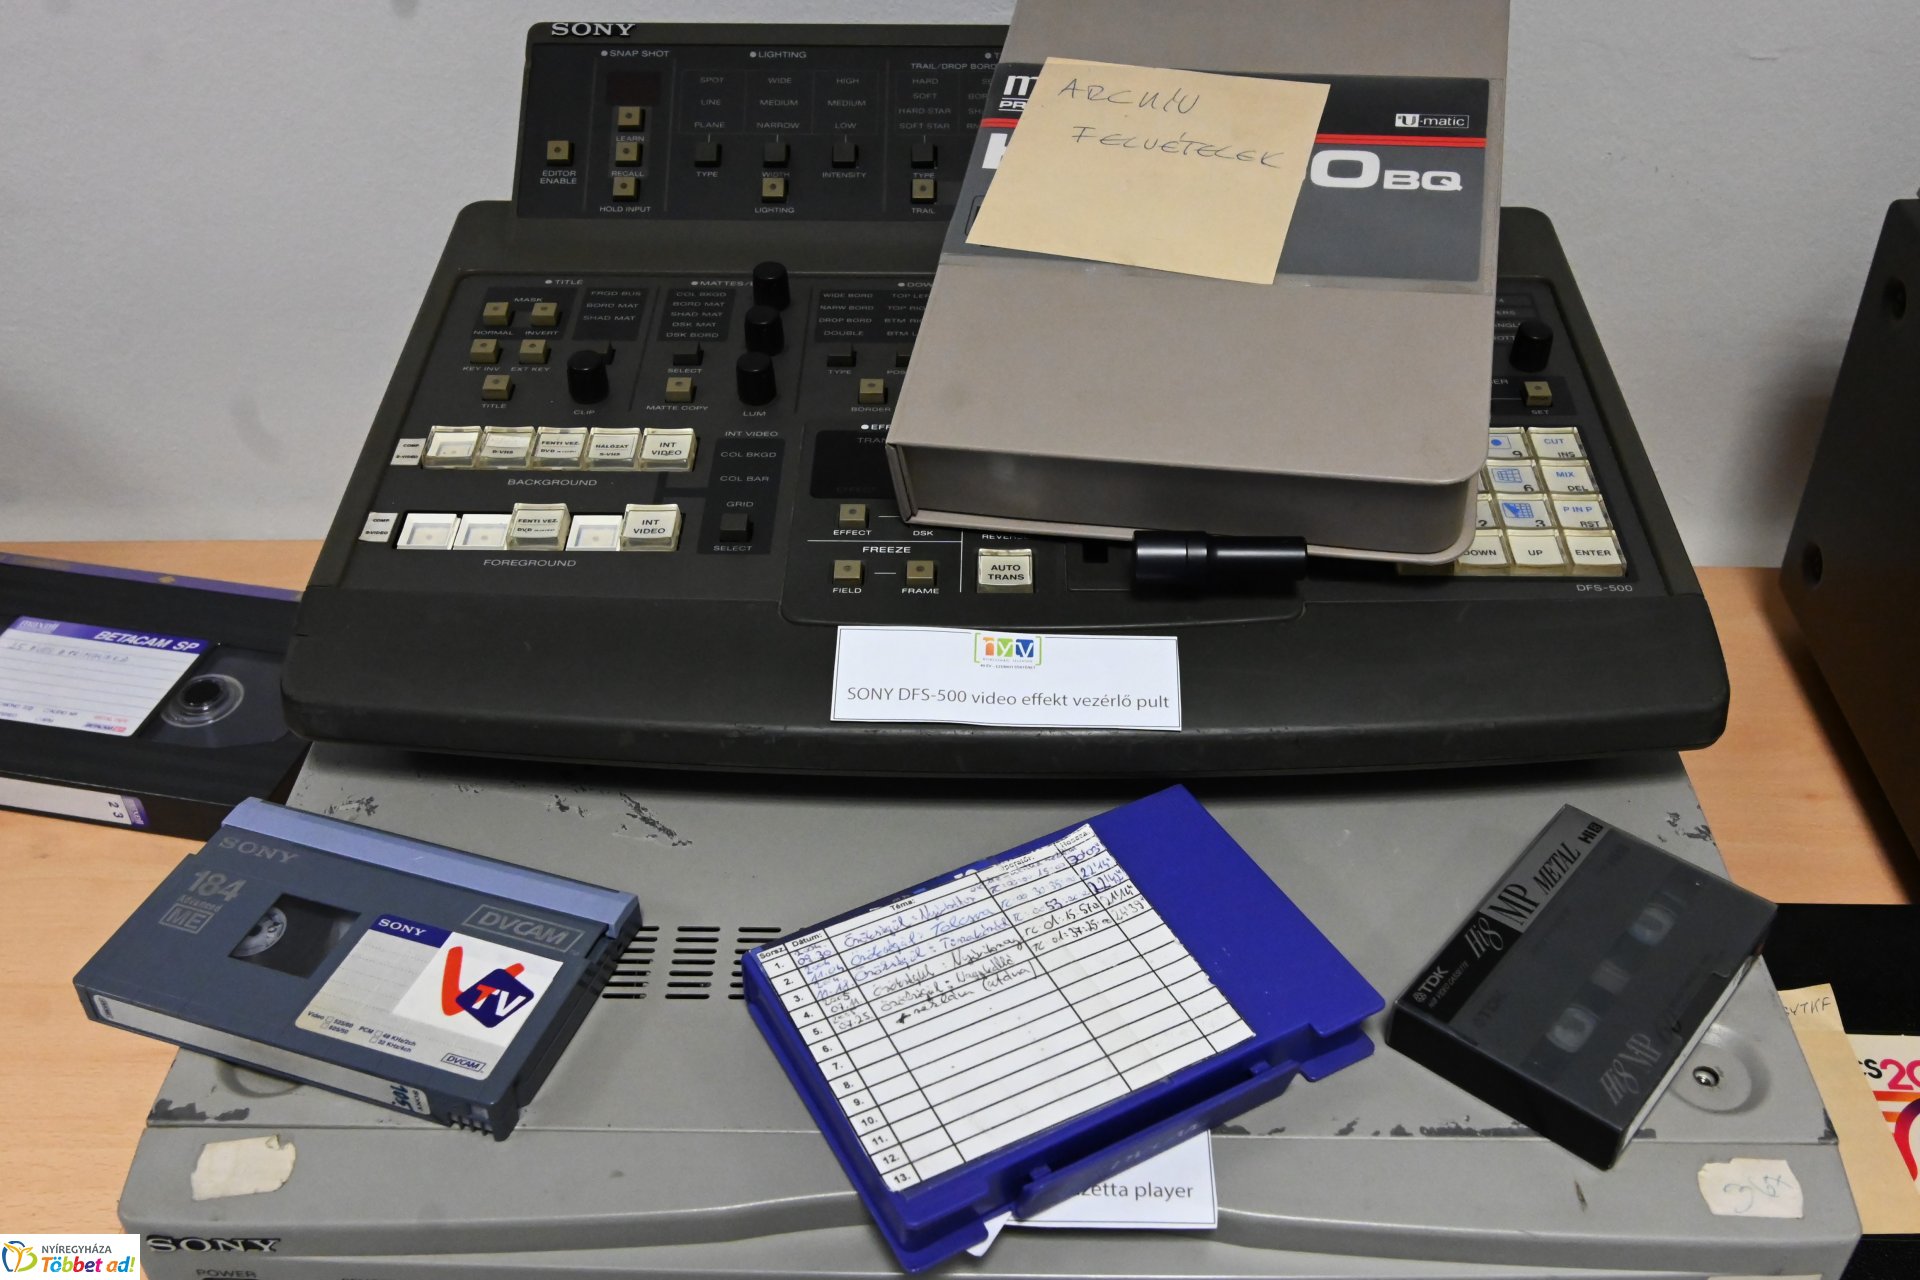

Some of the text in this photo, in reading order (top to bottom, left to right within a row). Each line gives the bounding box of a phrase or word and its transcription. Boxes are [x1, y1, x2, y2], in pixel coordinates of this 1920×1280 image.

[551, 22, 636, 36] SONY
[483, 559, 576, 567] FOREGROUND
[1576, 584, 1633, 592] DFS-500
[94, 630, 200, 652] BETACAM SP
[847, 687, 1169, 711] SONY DFS-500 video effekt vezérlő pult
[218, 836, 299, 864] SONY
[184, 870, 248, 902] 184
[1487, 842, 1582, 926] MP METAL
[890, 899, 916, 912] Téma:
[163, 907, 206, 930] ME
[378, 917, 428, 938] SONY
[479, 910, 569, 946] DVCAM
[791, 932, 823, 948] Dátum:
[1463, 917, 1505, 959] Hi8
[783, 977, 794, 986] 2.
[1417, 965, 1449, 993] TDK
[793, 995, 804, 1003] 3.
[803, 1011, 814, 1019] 4.
[308, 1010, 375, 1035] Video PCM
[812, 1028, 823, 1036] 5.
[822, 1043, 834, 1053] 6.
[446, 1054, 481, 1071] DVCAM
[831, 1061, 844, 1071] 7.
[843, 1079, 855, 1090] 8.
[852, 1097, 865, 1107] 9.
[860, 1115, 879, 1127] 10.
[871, 1134, 888, 1146] 11.
[882, 1153, 900, 1165] 12.
[893, 1172, 912, 1184] 13.
[1134, 1181, 1194, 1201] player
[147, 1236, 281, 1252] SONY
[195, 1268, 257, 1279] POWER
